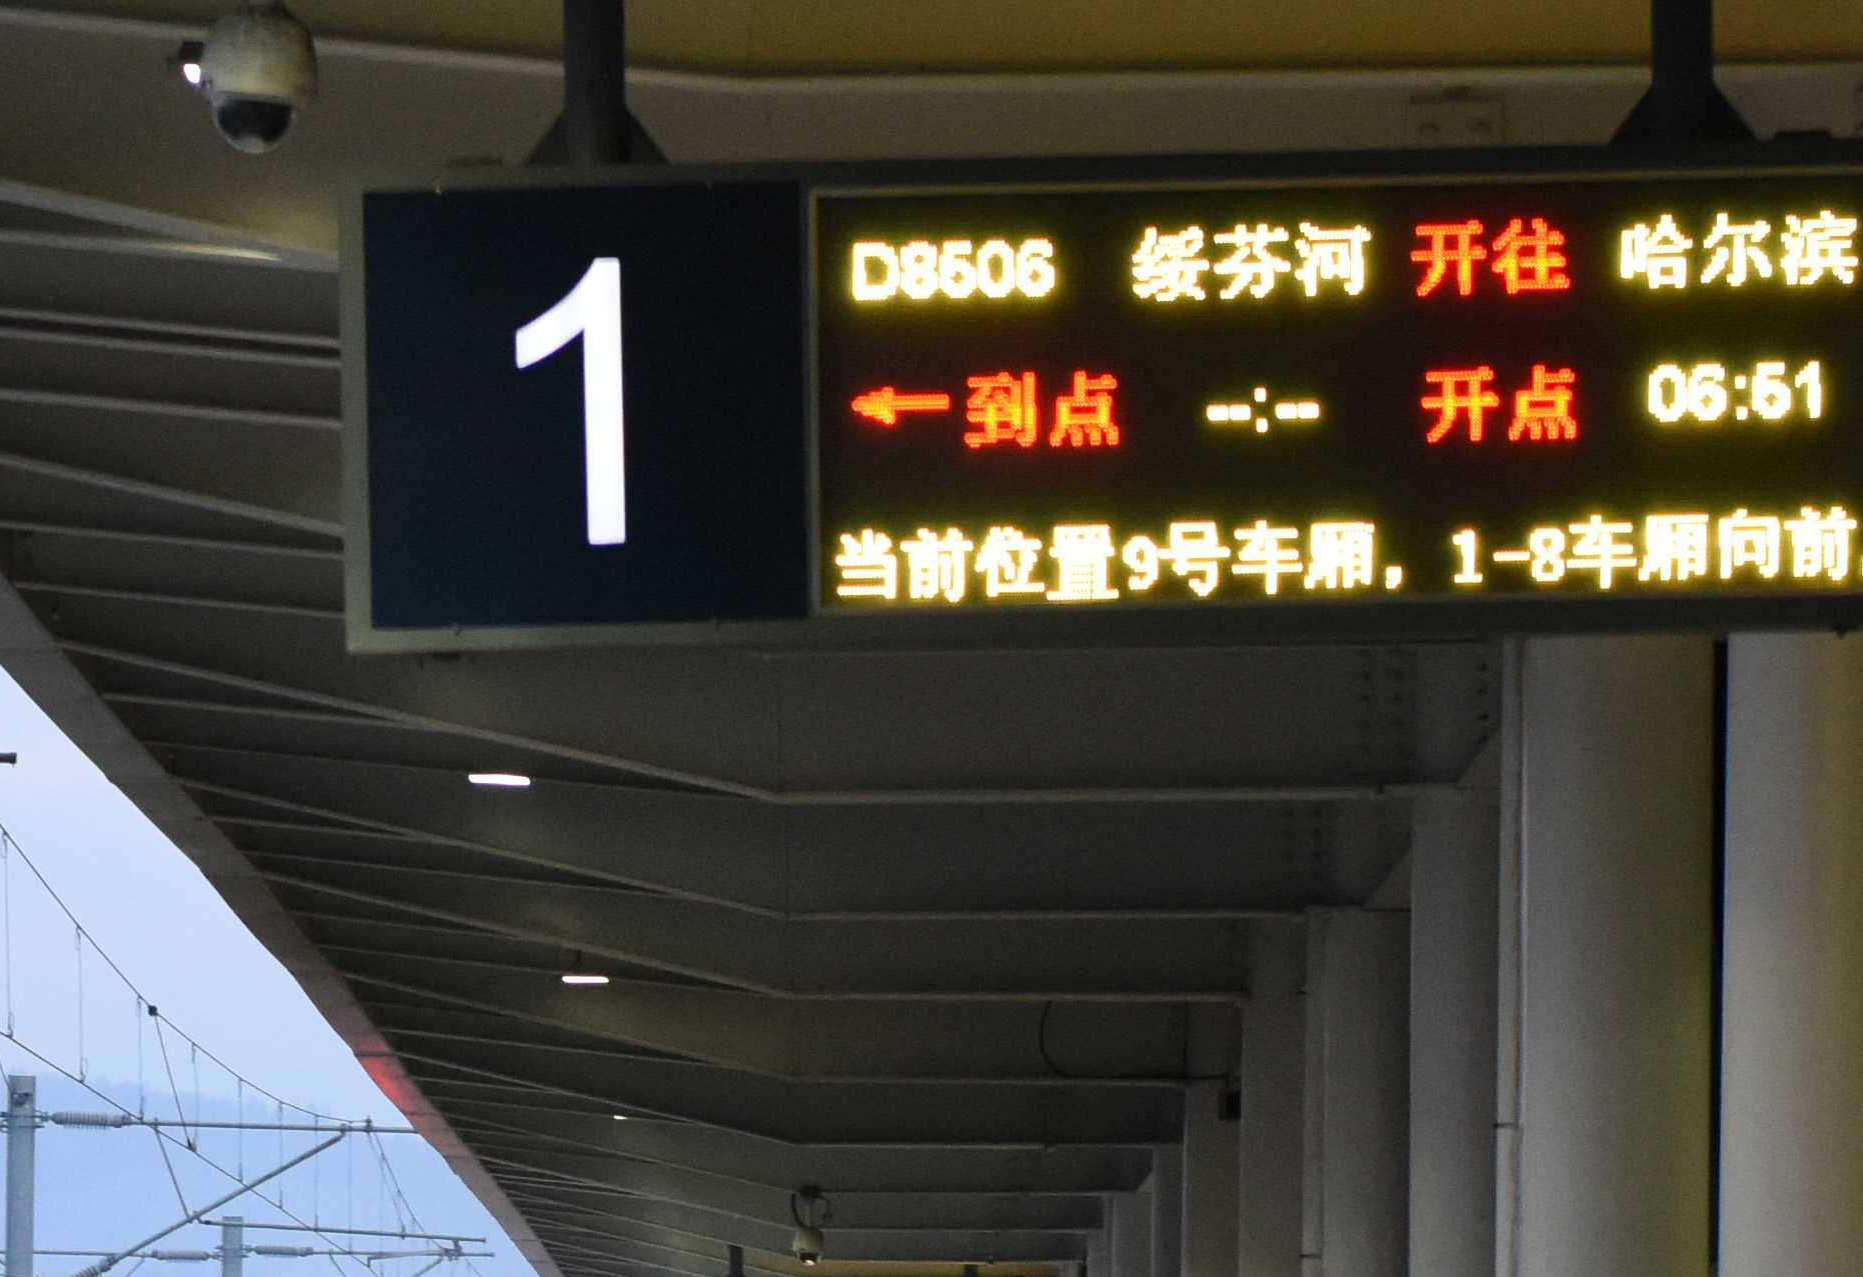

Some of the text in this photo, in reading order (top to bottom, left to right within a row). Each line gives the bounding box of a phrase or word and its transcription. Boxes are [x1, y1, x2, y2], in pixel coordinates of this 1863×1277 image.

[850, 209, 1858, 303] D8506 绥芬河 开往 哈尔滨
[516, 257, 626, 546] 1
[964, 370, 1120, 449] 到点
[1421, 364, 1578, 443] 开点
[1647, 360, 1824, 423] 06:51
